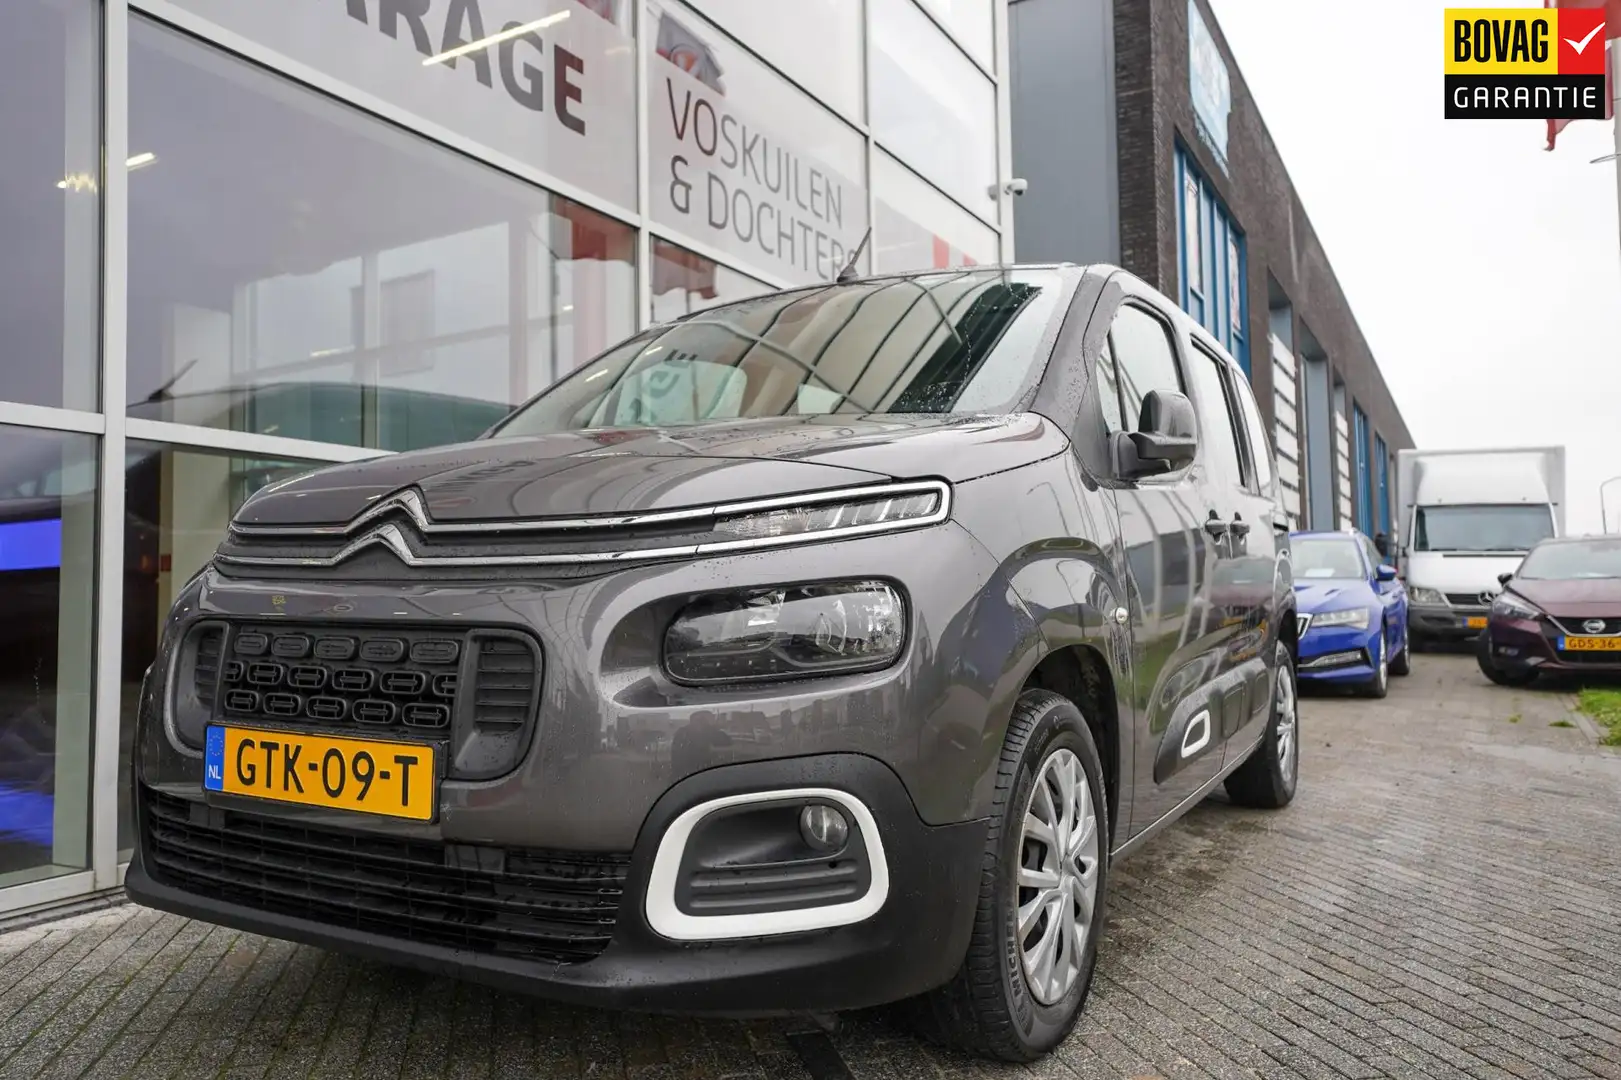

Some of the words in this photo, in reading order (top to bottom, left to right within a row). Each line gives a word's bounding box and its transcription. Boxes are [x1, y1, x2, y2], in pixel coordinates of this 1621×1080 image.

[345, 0, 586, 136] RAGE
[666, 77, 842, 230] VOSKUILEN
[669, 155, 691, 214] &
[208, 765, 221, 780] NL
[236, 738, 418, 807] GTK-09-T
[1006, 897, 1023, 998] MICHEL
